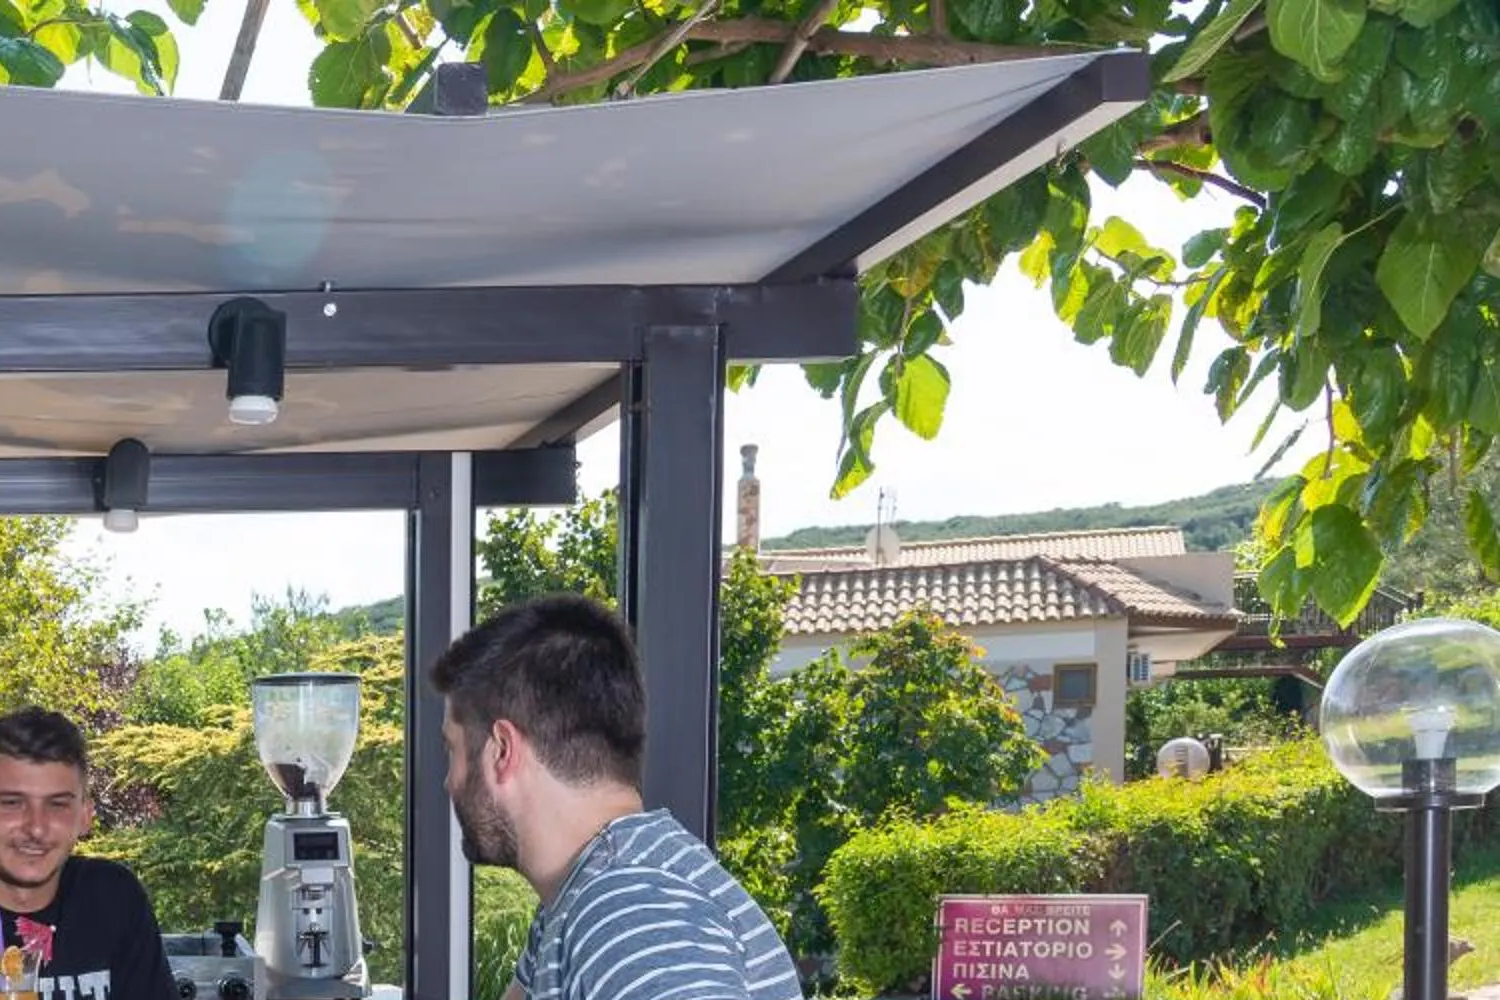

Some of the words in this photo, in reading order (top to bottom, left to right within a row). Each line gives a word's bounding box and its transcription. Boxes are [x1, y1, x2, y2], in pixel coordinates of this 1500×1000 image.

[954, 918, 1090, 936] RECEPTION
[953, 940, 1093, 959] ΕΣΤΙΑΤΟΡΙΟ
[953, 962, 1030, 980] ΠΙΣΙΝΑ
